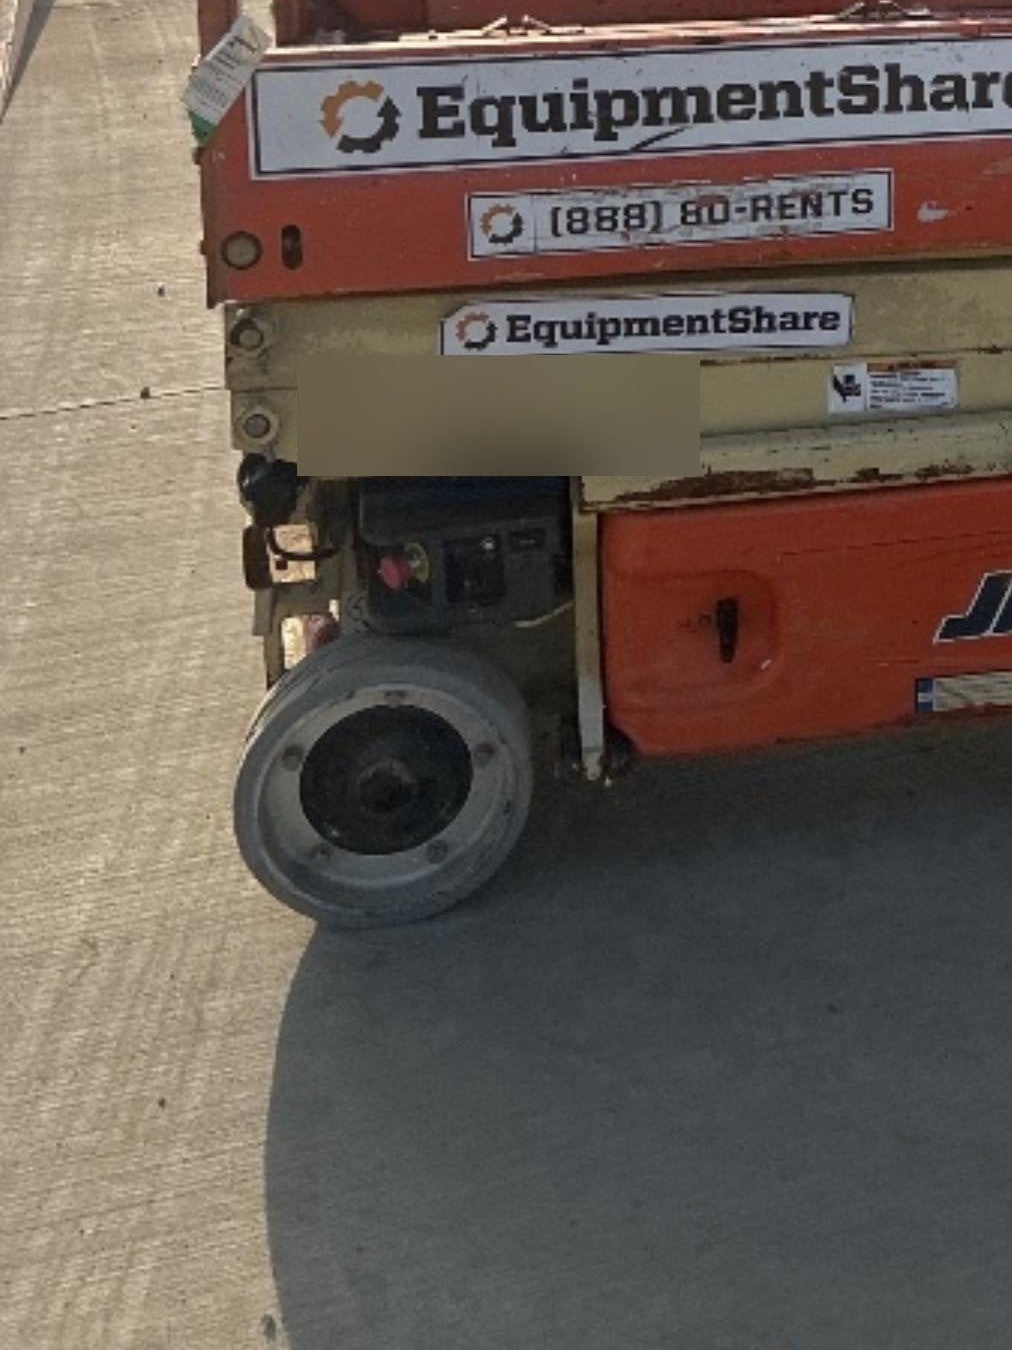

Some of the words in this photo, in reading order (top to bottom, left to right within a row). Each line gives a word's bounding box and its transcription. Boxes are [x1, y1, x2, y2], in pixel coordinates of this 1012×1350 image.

[551, 201, 663, 237] (888)
[680, 188, 874, 226] 80-RENTS
[505, 305, 841, 348] EquipmentShare
